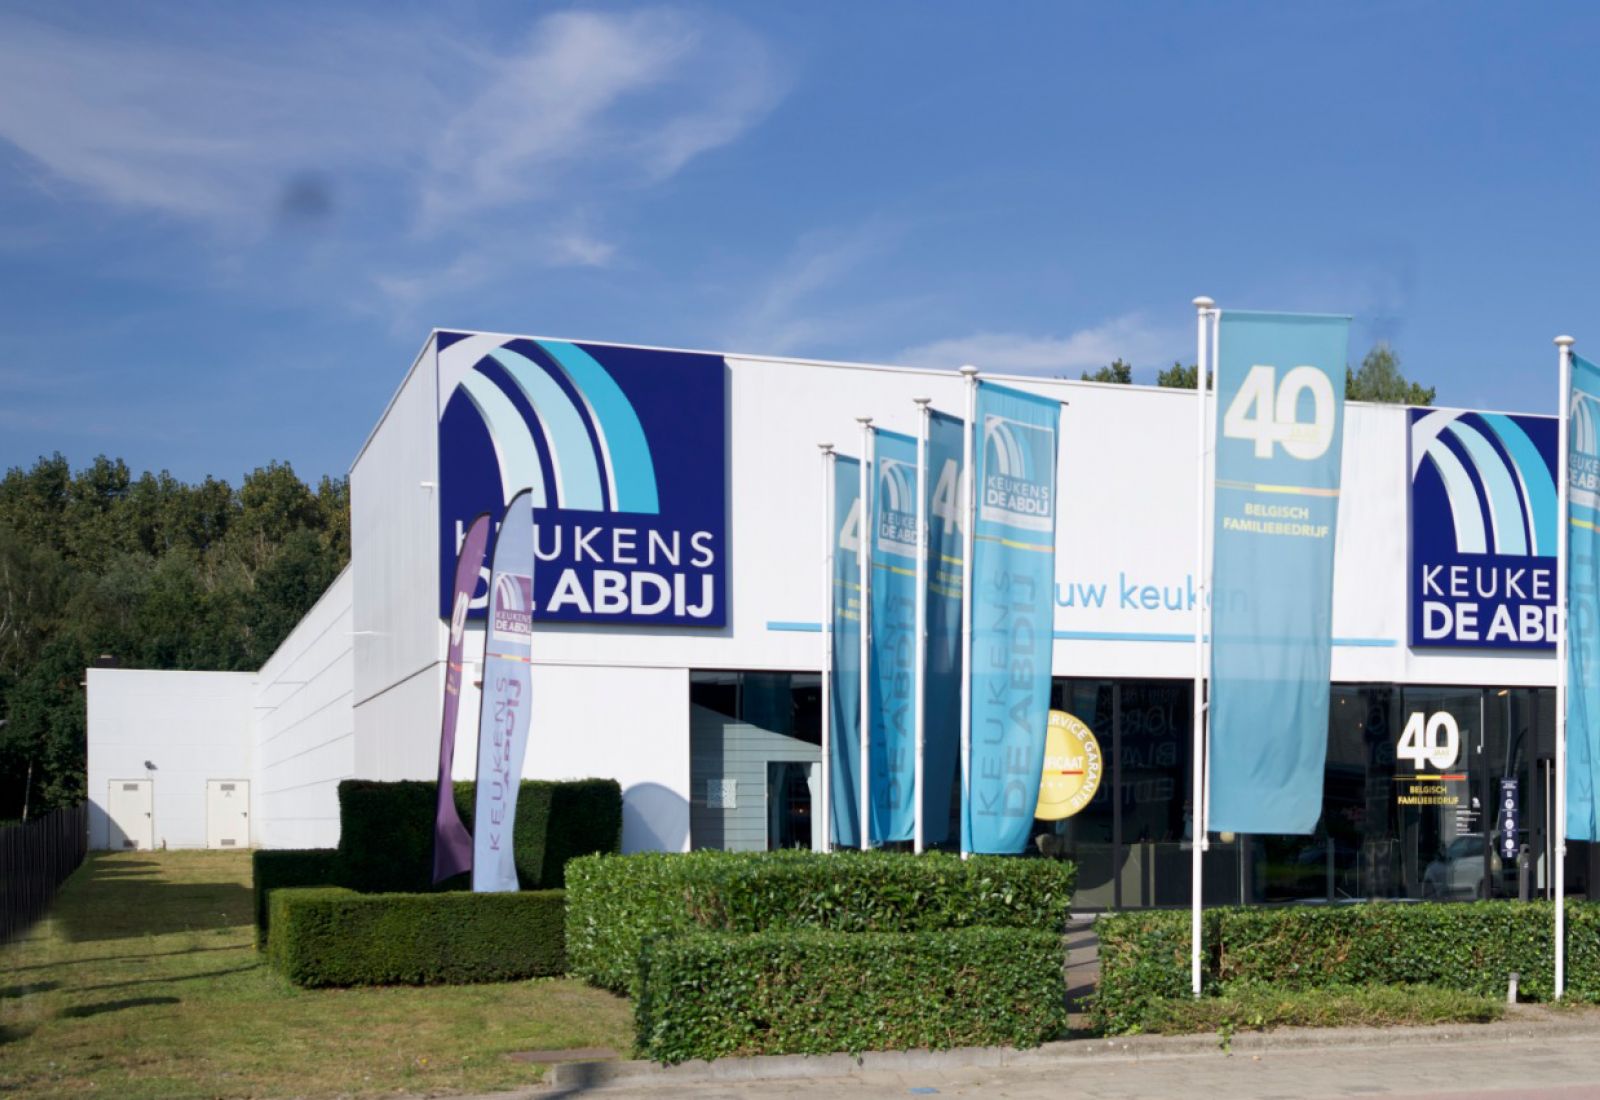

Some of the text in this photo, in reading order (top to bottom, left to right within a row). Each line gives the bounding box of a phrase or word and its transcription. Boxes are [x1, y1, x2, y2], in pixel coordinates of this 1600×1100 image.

[1224, 365, 1335, 460] 40
[987, 489, 1008, 507] DE
[988, 475, 1050, 499] KEUKENS
[1244, 503, 1309, 520] BELGISCH
[455, 520, 714, 567] UKENS
[546, 568, 714, 617] ABDIJ
[1055, 582, 1107, 608] uw
[1423, 564, 1551, 600] KEUKE
[1423, 601, 1567, 644] DE ABD
[976, 570, 1011, 817] KEUKENS
[1002, 573, 1037, 818] DE ABDIJ
[1049, 713, 1088, 741] RVICE
[1397, 711, 1459, 770] 40
[489, 678, 510, 851] KEUKENS
[1410, 785, 1447, 794] BELGISCH
